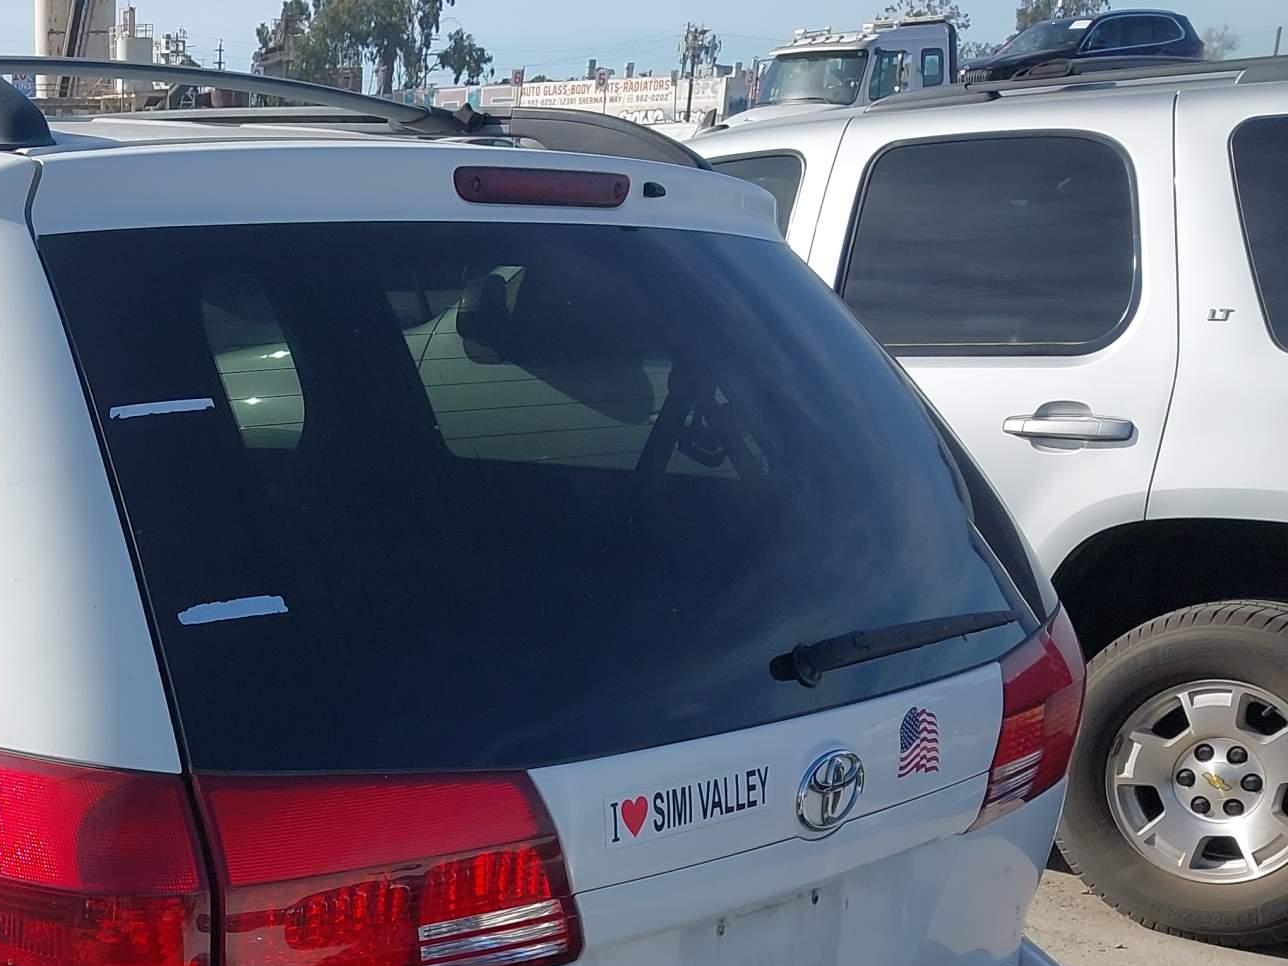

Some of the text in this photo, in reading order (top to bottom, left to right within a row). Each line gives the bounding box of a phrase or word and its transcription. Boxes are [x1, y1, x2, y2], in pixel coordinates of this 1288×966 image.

[514, 72, 521, 84] 6
[598, 72, 606, 86] 5
[521, 86, 541, 96] AUTO
[1207, 309, 1236, 321] LT
[610, 766, 769, 843] I SIMI VALLEY
